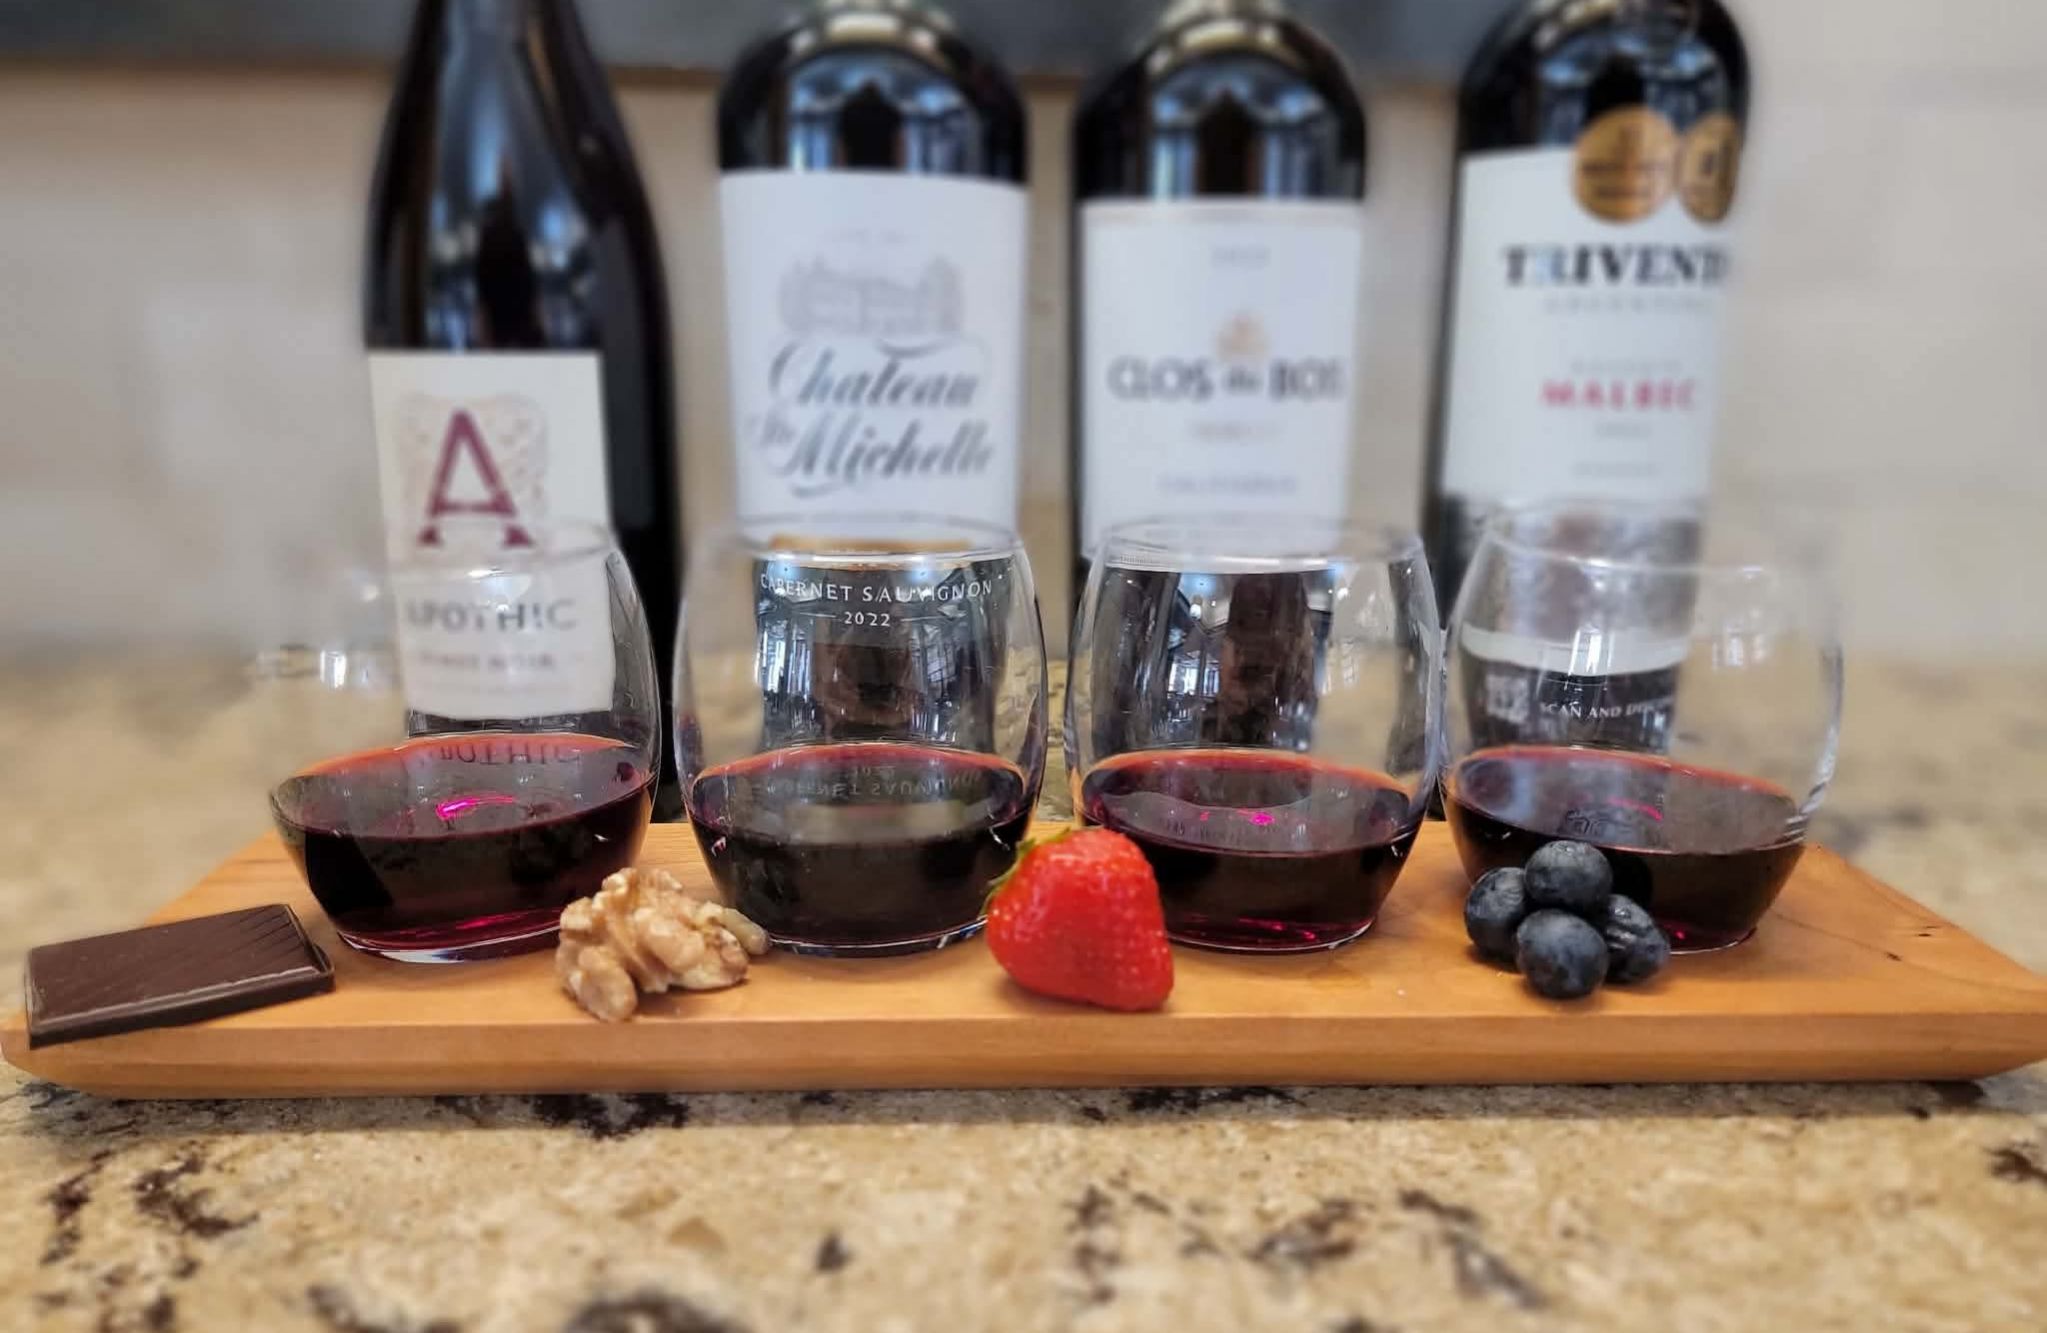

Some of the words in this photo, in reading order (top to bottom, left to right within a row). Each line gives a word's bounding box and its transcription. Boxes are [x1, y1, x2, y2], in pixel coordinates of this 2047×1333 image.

[418, 409, 534, 546] A
[760, 573, 853, 602] CABERNET
[863, 579, 993, 603] SAUVIGNON
[844, 611, 891, 627] 2022
[1588, 706, 1621, 719] AND
